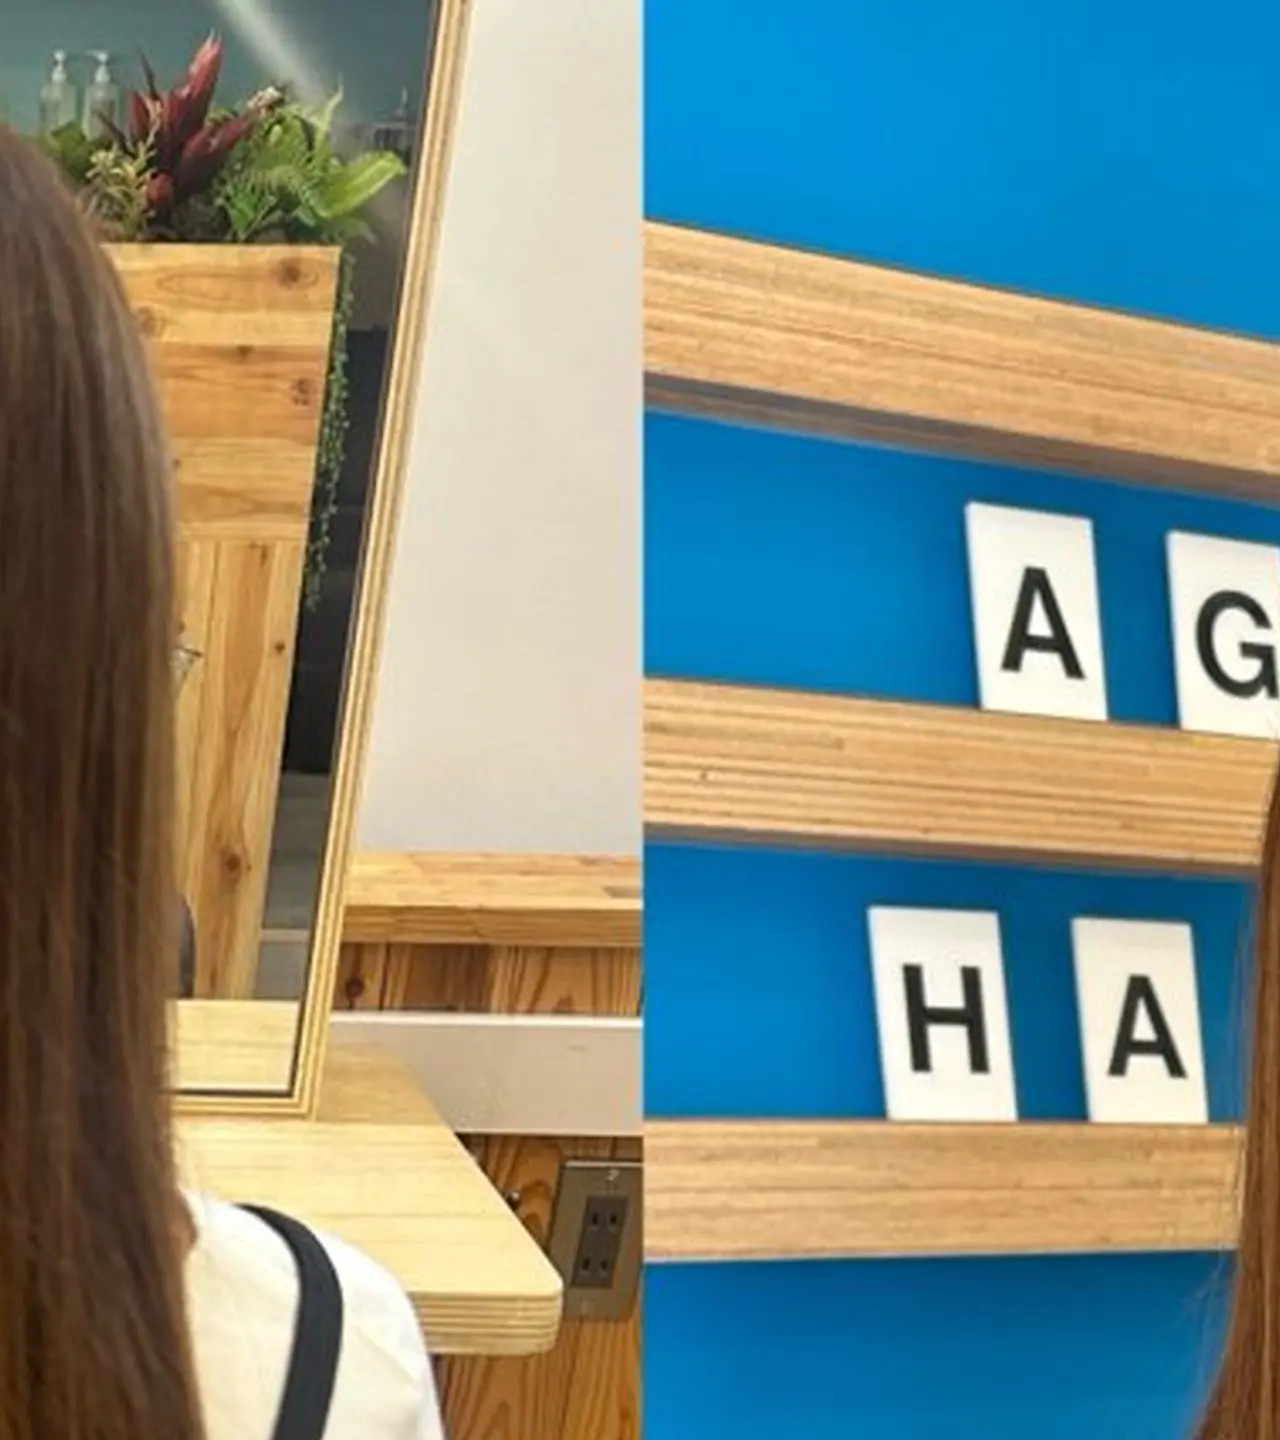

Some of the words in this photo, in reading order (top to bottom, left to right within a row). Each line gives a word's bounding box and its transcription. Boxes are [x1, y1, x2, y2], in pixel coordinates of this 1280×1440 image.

[1000, 566, 1085, 680] A
[1195, 590, 1280, 700] G
[901, 964, 990, 1076] H
[1107, 974, 1188, 1080] A
